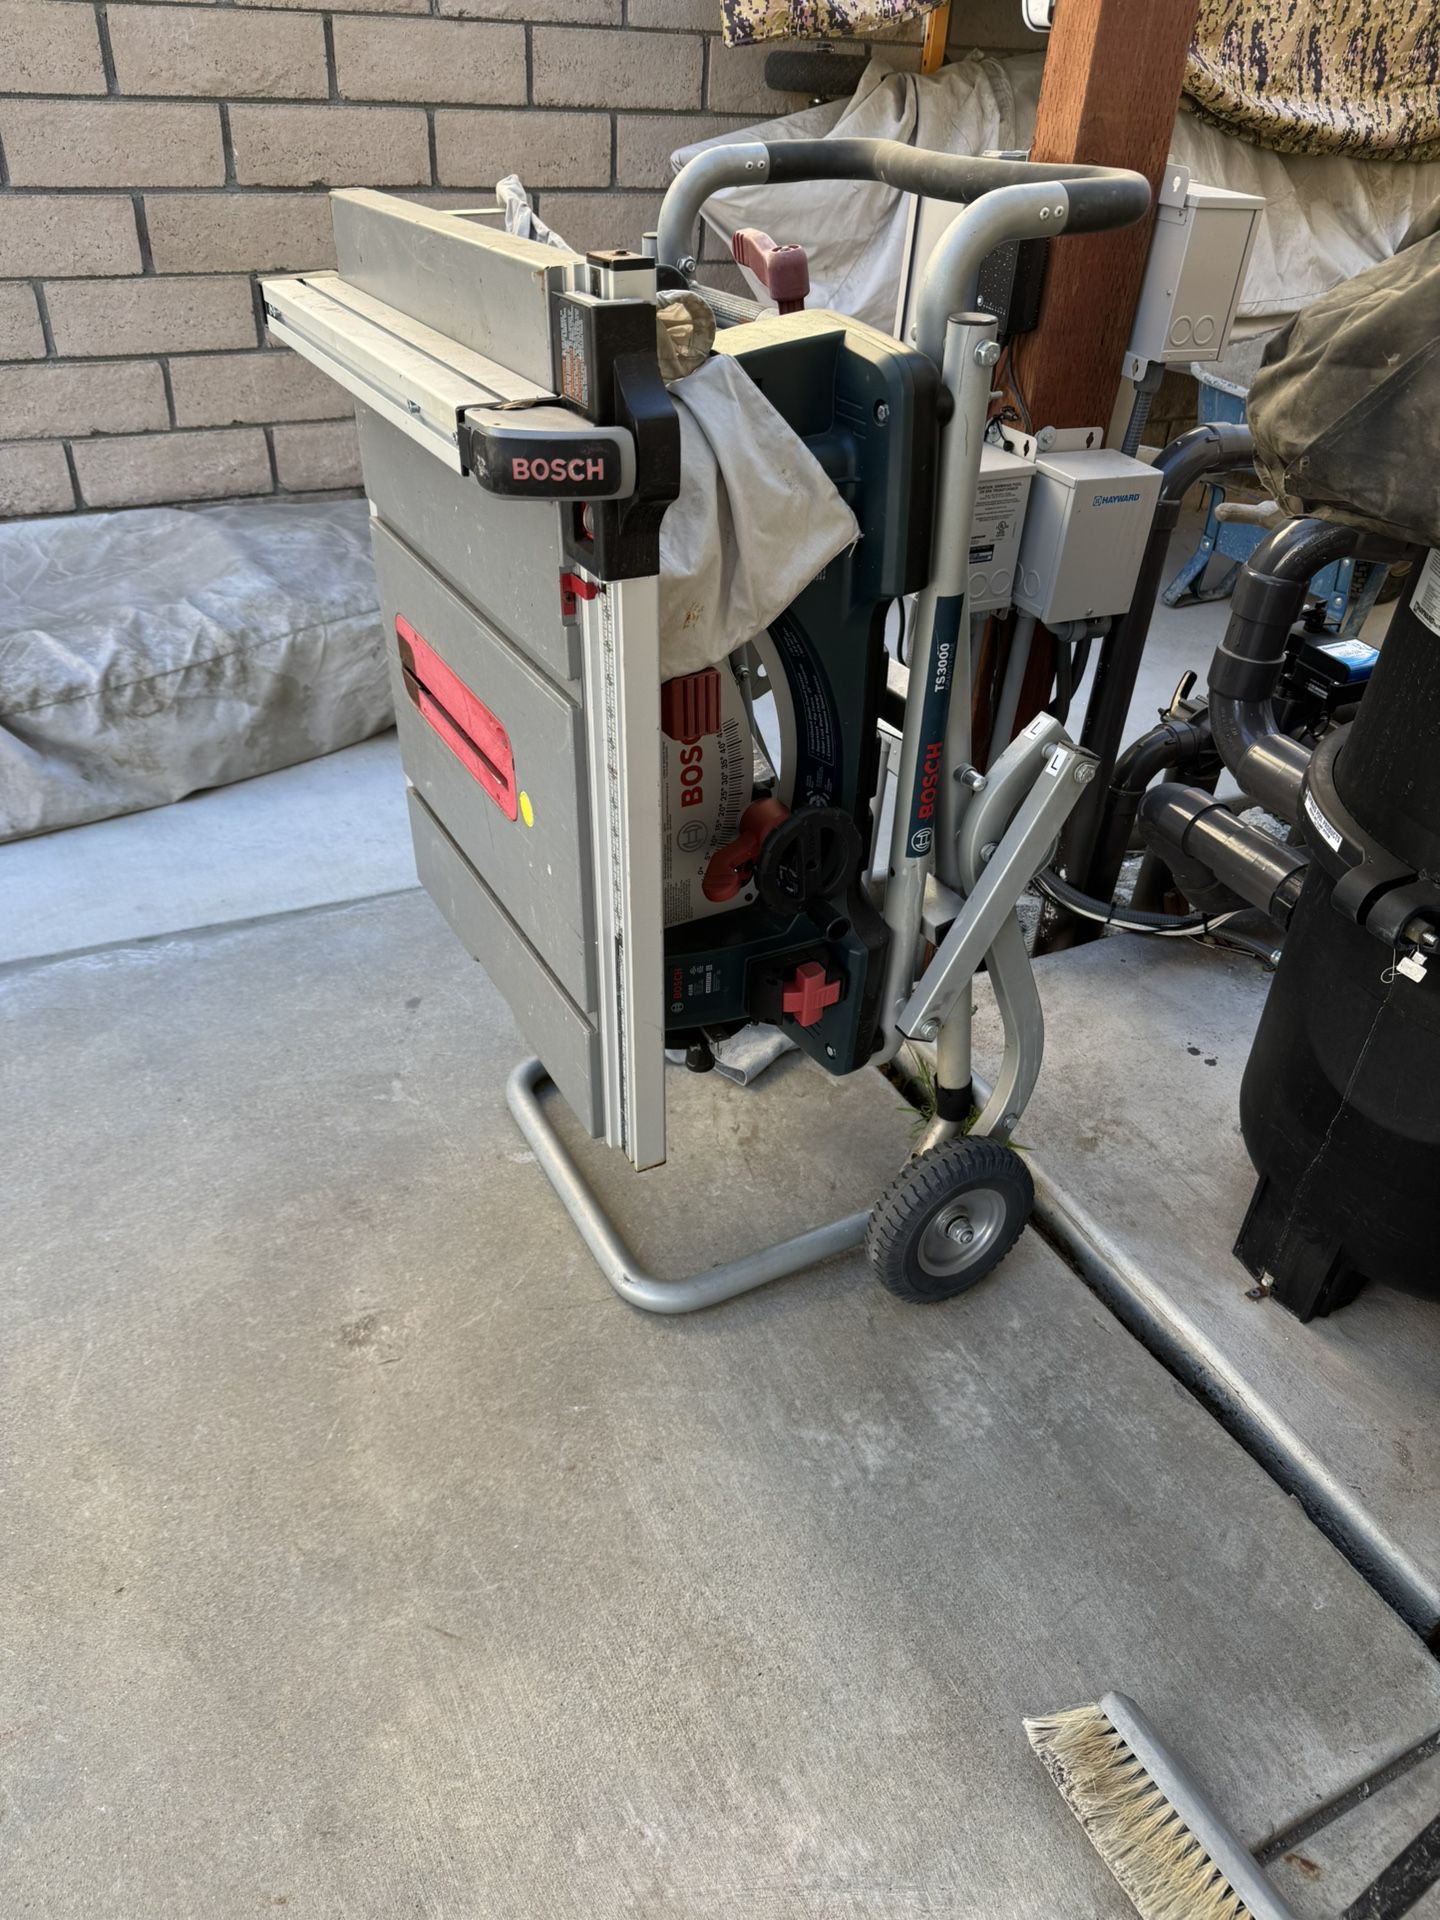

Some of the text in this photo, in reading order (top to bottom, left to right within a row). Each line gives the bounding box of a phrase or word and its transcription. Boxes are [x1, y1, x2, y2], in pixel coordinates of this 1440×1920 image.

[512, 458, 604, 482] BOSCH
[1102, 493, 1140, 506] HAYWARD
[934, 643, 950, 692] TS3000
[918, 742, 944, 820] BOSCH
